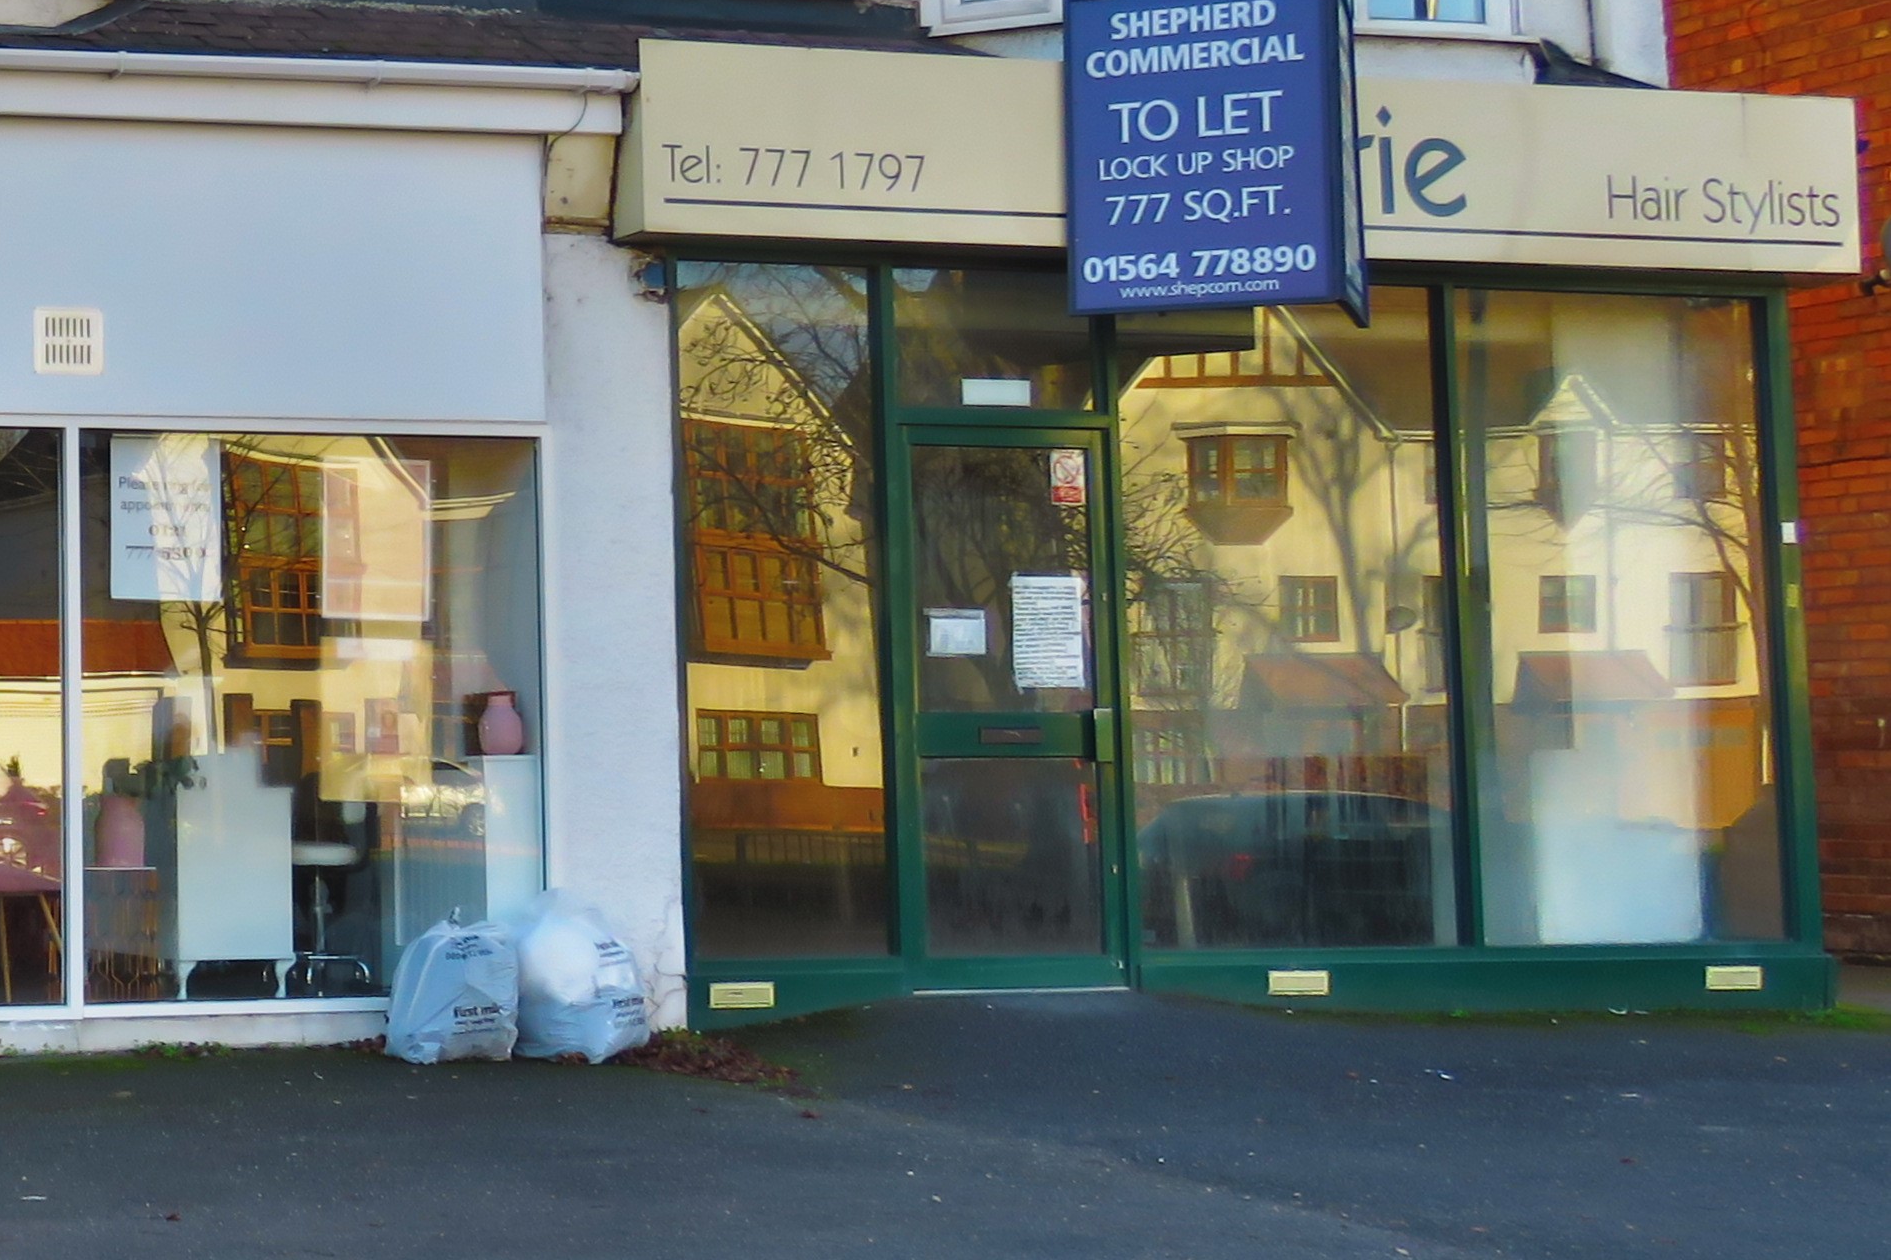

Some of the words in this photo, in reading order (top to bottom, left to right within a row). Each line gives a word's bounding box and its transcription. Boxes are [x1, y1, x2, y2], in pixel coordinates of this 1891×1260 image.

[1110, 0, 1276, 40] SHEPHERD
[1086, 34, 1304, 78] COMMERCIAL
[1108, 100, 1179, 144] TO
[1197, 90, 1283, 138] LET
[662, 144, 721, 183] Tel:
[739, 147, 811, 188] 777
[830, 151, 925, 192] 1797
[1099, 154, 1168, 180] LOCK
[1177, 152, 1212, 175] UP
[1222, 145, 1294, 172] SHOP
[1105, 193, 1171, 225] 777
[1183, 184, 1292, 223] SQ.FT.
[1607, 174, 1688, 222] Hair
[1702, 177, 1840, 234] Stylists
[1083, 252, 1180, 283] 01564
[1191, 244, 1316, 277] 778890
[1120, 277, 1279, 298] www.shepcom.com
